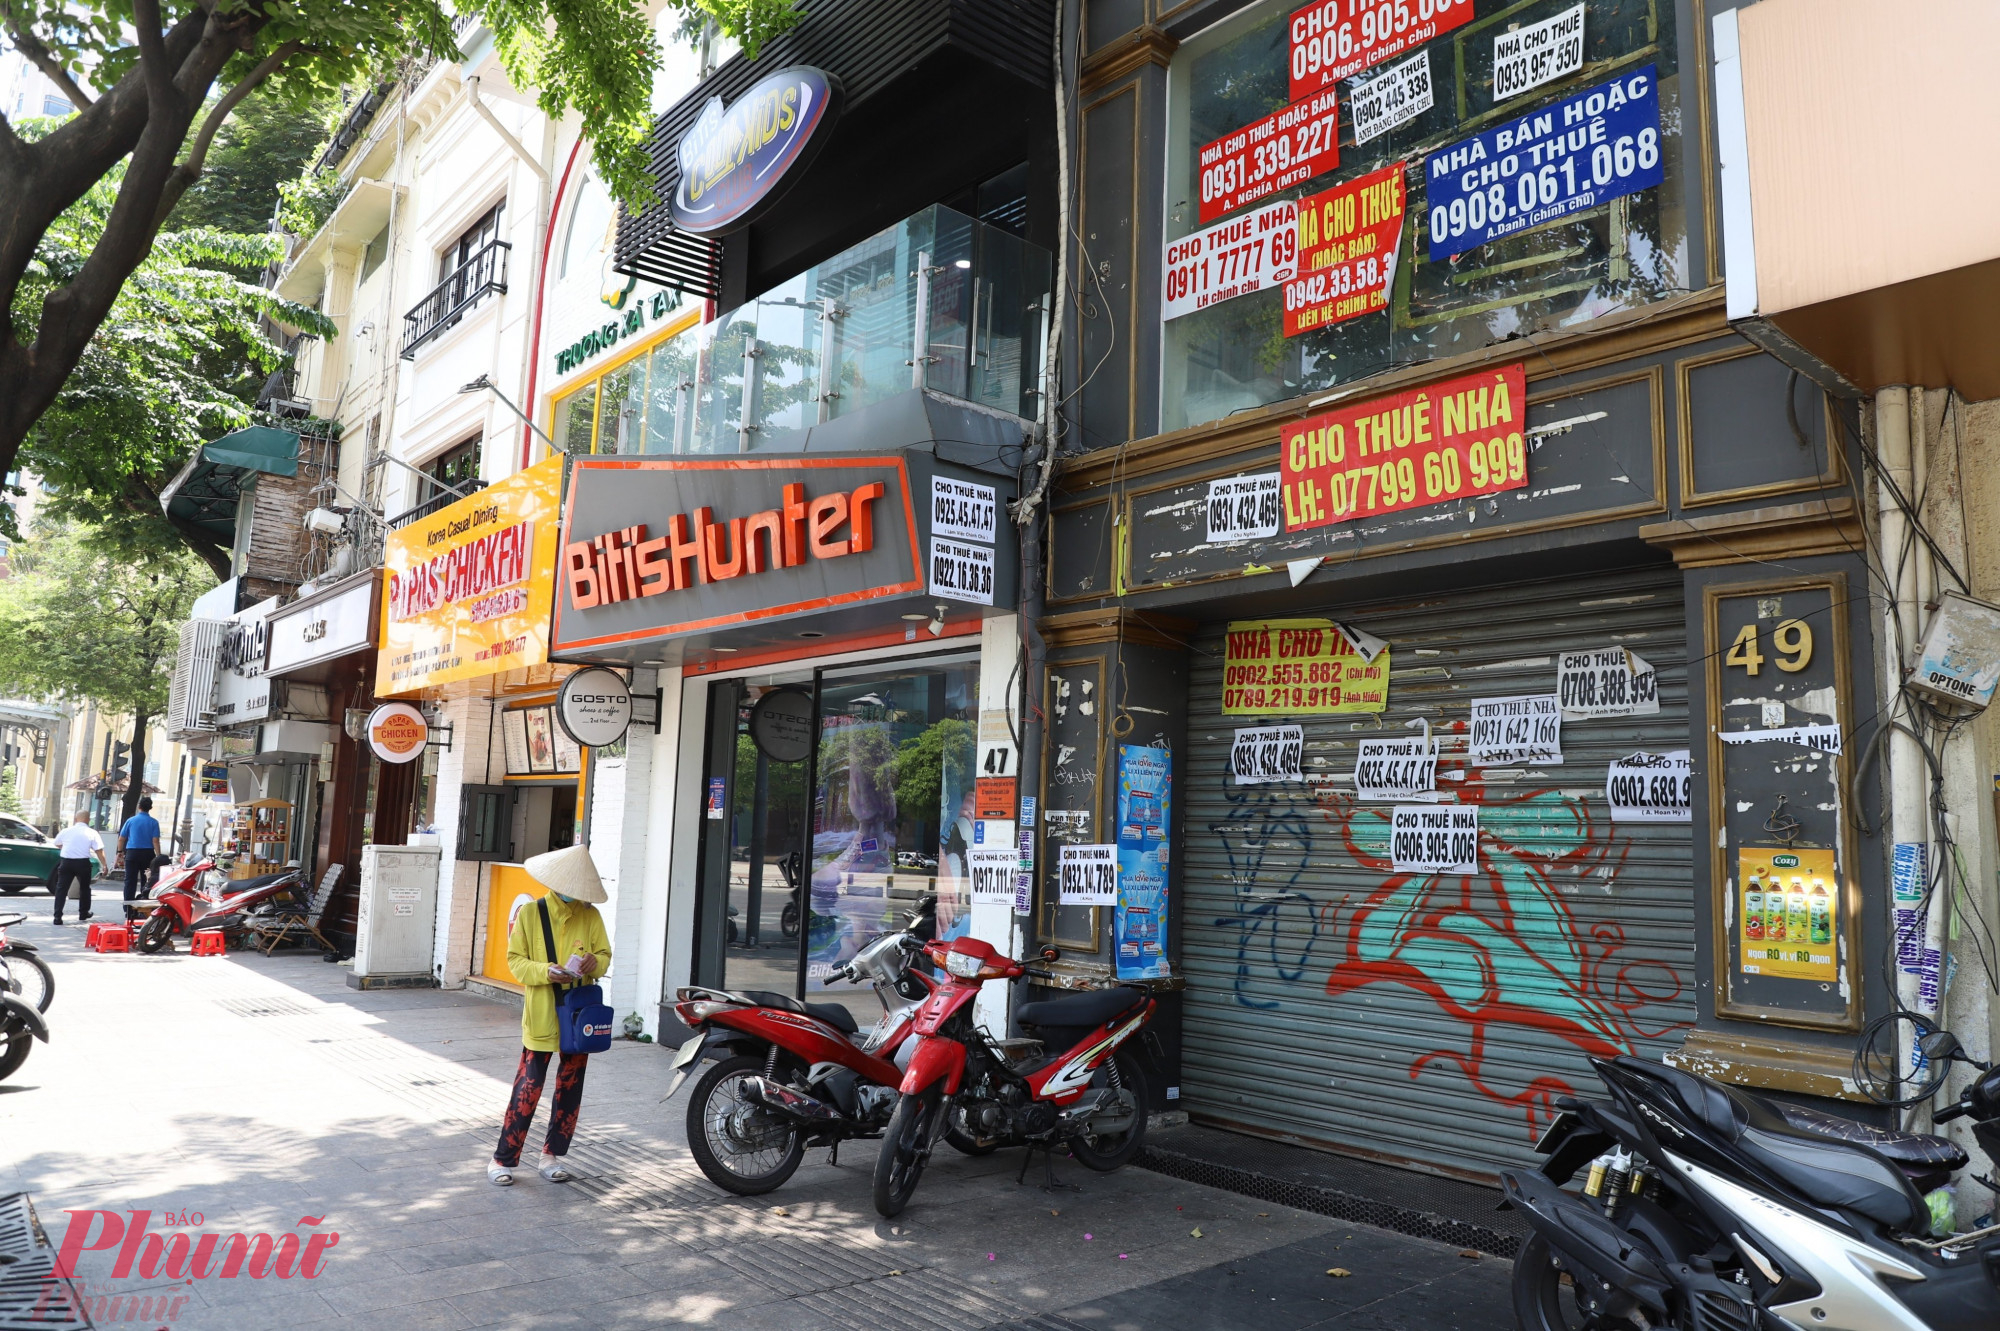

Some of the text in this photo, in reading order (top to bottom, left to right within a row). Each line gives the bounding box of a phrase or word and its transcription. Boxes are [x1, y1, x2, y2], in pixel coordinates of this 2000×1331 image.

[1292, 0, 1338, 44] CHO
[1292, 0, 1467, 81] 0906.905.0
[1497, 34, 1520, 60] NHÀ
[1524, 28, 1548, 51] CHO
[1551, 10, 1580, 40] THUÊ
[1321, 21, 1437, 86] A.Ngọc (chính chủ)
[1497, 58, 1527, 95] 0933
[1531, 48, 1554, 83] 957
[1556, 37, 1579, 72] 550
[1353, 53, 1427, 105] NHÀ CHO THUÊ
[1356, 71, 1429, 127] 0902 445 338
[1201, 91, 1336, 167] NHÀ CHO THUÊ HOẶC BÁN
[1432, 75, 1649, 179] NHÀ BÁN HOẶC
[1202, 113, 1335, 204] 0931.339.227
[1461, 116, 1607, 192] CHO THUÊ
[1223, 164, 1312, 212] A. NGHĨA (MTG)
[1431, 126, 1659, 244] 0908.061.068
[1297, 168, 1402, 251] HÀ CHO THUÊ
[1486, 191, 1595, 240] A.Danh (chính chủ)
[1167, 237, 1202, 266] CHO
[1207, 202, 1252, 251] THUÊ
[1311, 232, 1377, 272] (HOẶC BÁN)
[1167, 228, 1296, 302] 0911 7777 69
[1286, 251, 1394, 312] 0942.33.58.3
[1197, 275, 1260, 309] LH chính chủ
[1297, 288, 1386, 330] LIÊN HỆ CHÍNH CH
[1288, 373, 1513, 473] CHO THUÊ NHÀ
[935, 481, 994, 503] CHO THUÊ NHÀ
[1214, 475, 1277, 496] CHO THUÊ NHÀ
[1283, 482, 1325, 526] LH:
[1330, 457, 1416, 517] 07799
[1423, 446, 1461, 498] 60
[1469, 431, 1524, 488] 999
[426, 504, 498, 547] Korea Casual Dining
[935, 496, 994, 532] 0925.45.47.47
[1210, 492, 1277, 533] 0931.432.469
[444, 520, 527, 604] CHICKEN
[935, 543, 988, 562] CHO THUÊ NHÀ
[934, 556, 992, 595] 0922.16.36.36
[1228, 624, 1323, 660] NHÀ CHO
[1726, 618, 1813, 676] 49
[1226, 661, 1343, 686] 0902.555.882
[1346, 667, 1364, 682] (Chị
[1564, 655, 1591, 669] CHO
[571, 694, 627, 704] GOSTO
[1225, 686, 1341, 709] 0789.219.919
[1343, 691, 1361, 705] (Anh
[1929, 671, 1977, 697] OPTONE
[387, 716, 412, 726] PAPAS
[603, 706, 620, 717] coffee
[1477, 696, 1556, 718] CHO THUÊ NHÀ
[381, 728, 418, 739] CHICKEN
[1239, 728, 1300, 744] CHO THUÊ NHÀ
[1362, 740, 1436, 756] CHO THUÊ NÀ
[1473, 716, 1558, 746] 0931 642 166
[1807, 728, 1840, 750] NHÀ
[984, 748, 1009, 774] 47
[1234, 742, 1300, 777] 0931.432.469
[1358, 760, 1433, 790] 0925.45.47.47
[1396, 808, 1475, 829] CHO THUÊ NHÀ
[986, 852, 998, 861] NHÀ
[1063, 848, 1110, 860] CHO THUÊ NHÀ
[1394, 831, 1475, 864] 0906.905.006
[1774, 856, 1797, 867] Cozy
